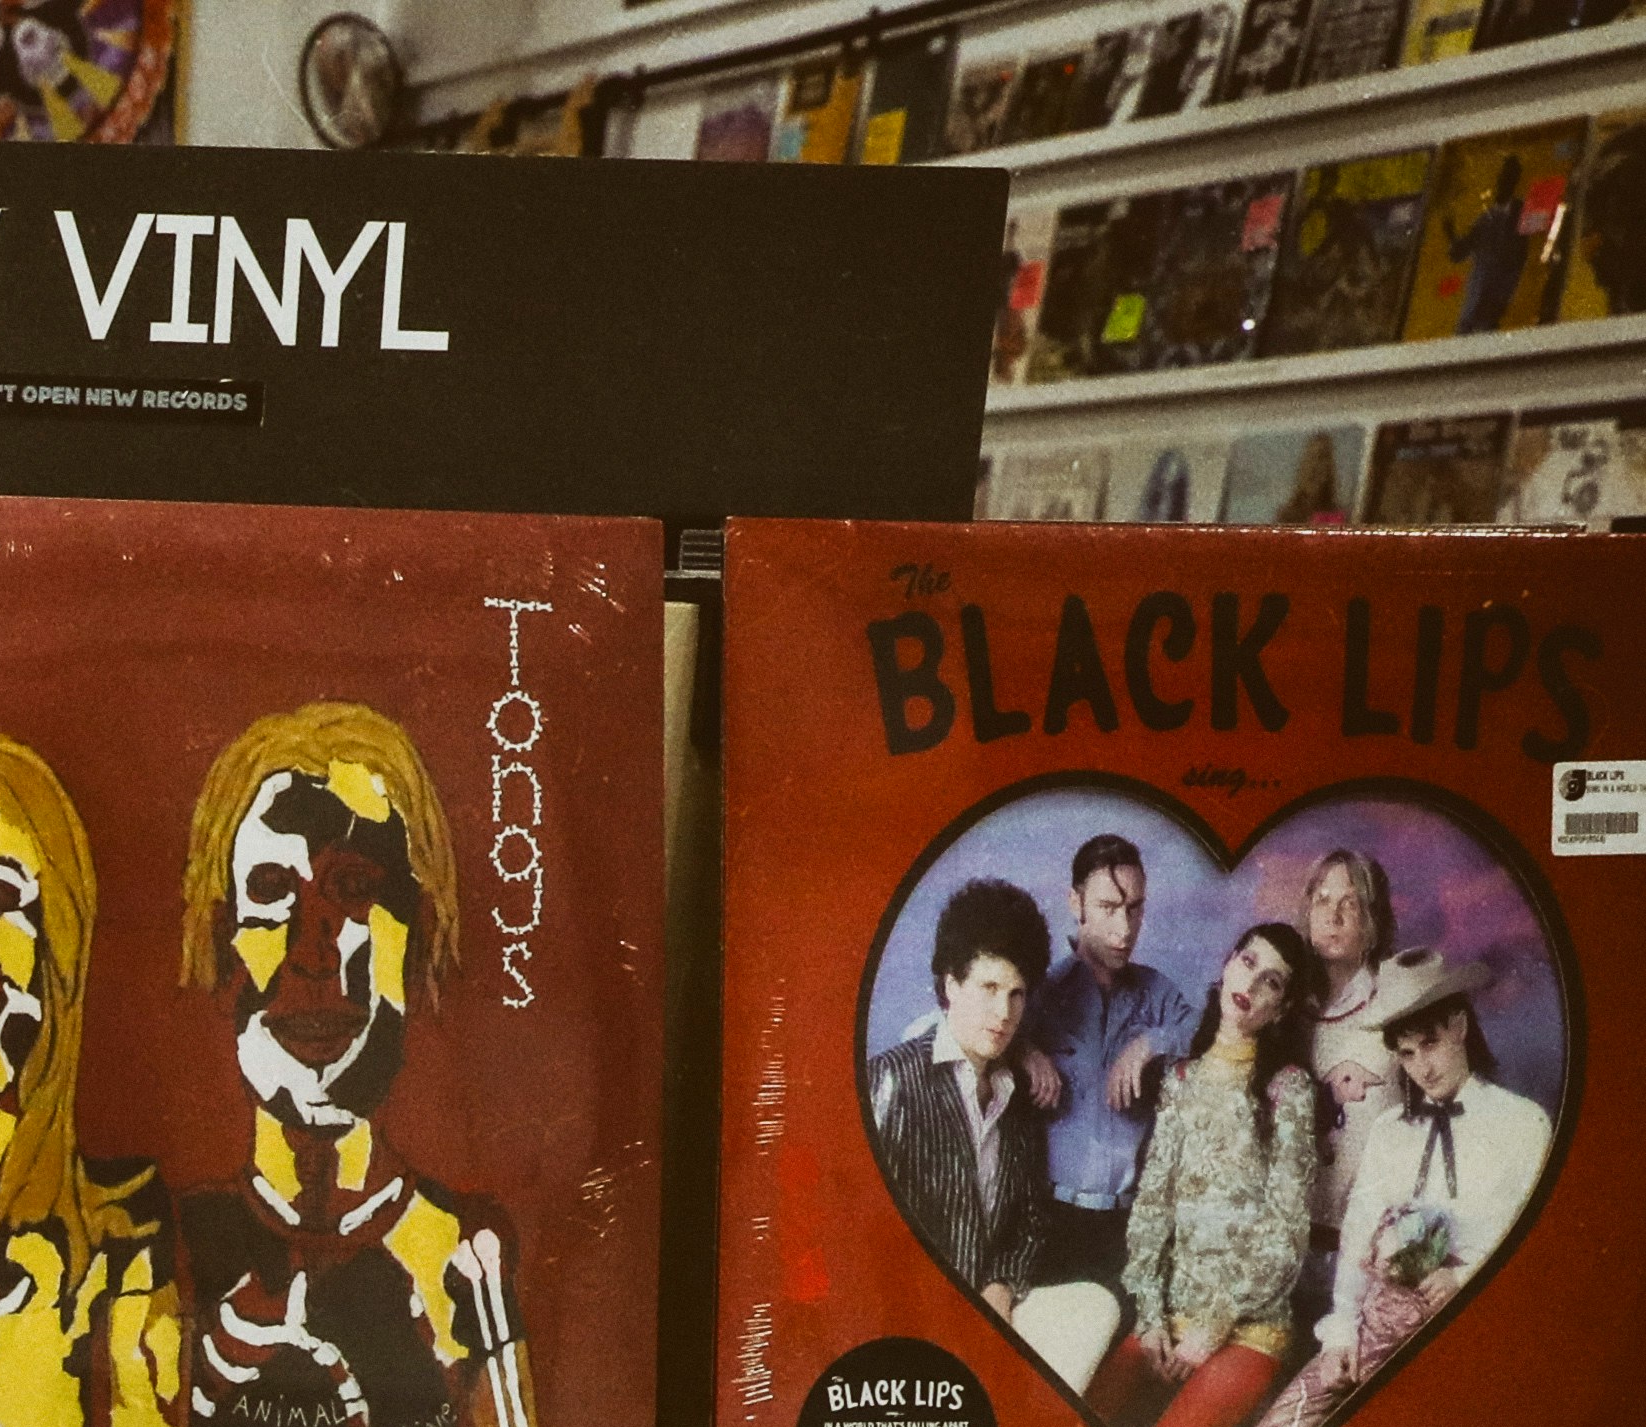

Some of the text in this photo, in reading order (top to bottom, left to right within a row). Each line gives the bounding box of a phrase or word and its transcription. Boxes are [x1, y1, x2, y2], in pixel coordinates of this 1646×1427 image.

[54, 209, 450, 352] VINYL
[23, 384, 80, 406] OPEN
[85, 387, 137, 409] NEW
[141, 388, 248, 412] RECORDS
[866, 589, 1605, 765] BLACK LIPS
[827, 1379, 964, 1412] BLACK LIPS
